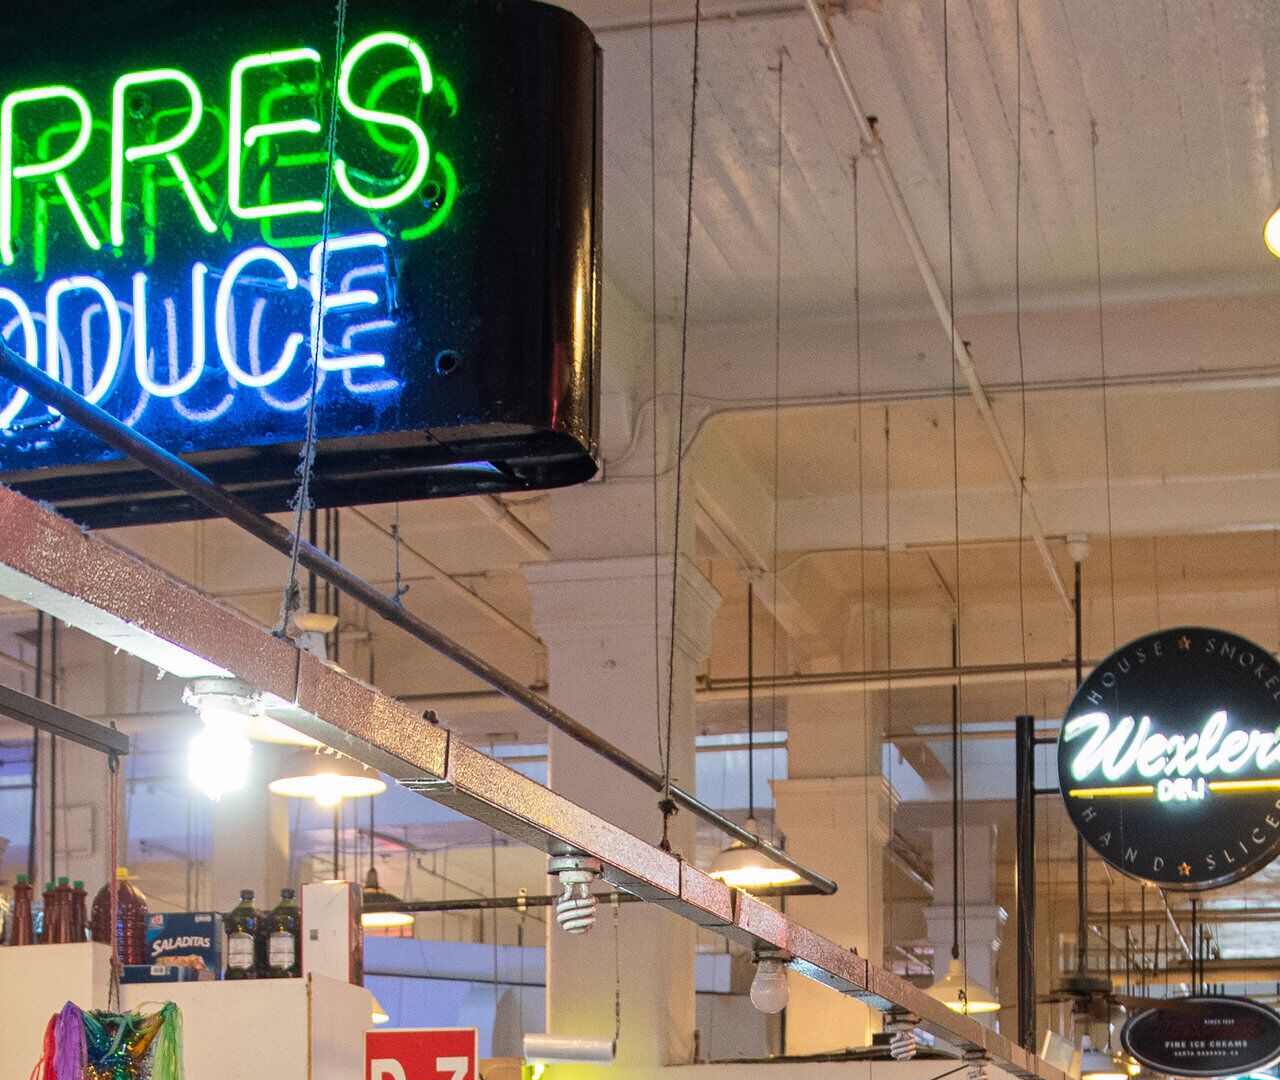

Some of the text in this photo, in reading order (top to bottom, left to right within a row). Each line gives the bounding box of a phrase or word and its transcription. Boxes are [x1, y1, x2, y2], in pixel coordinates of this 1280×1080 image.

[1086, 641, 1164, 707] HOUSE
[1157, 777, 1207, 802] DELI
[1081, 805, 1165, 873] HAND
[152, 935, 211, 957] SALADITAS
[1165, 1040, 1248, 1049] FINE ICE CREAMS
